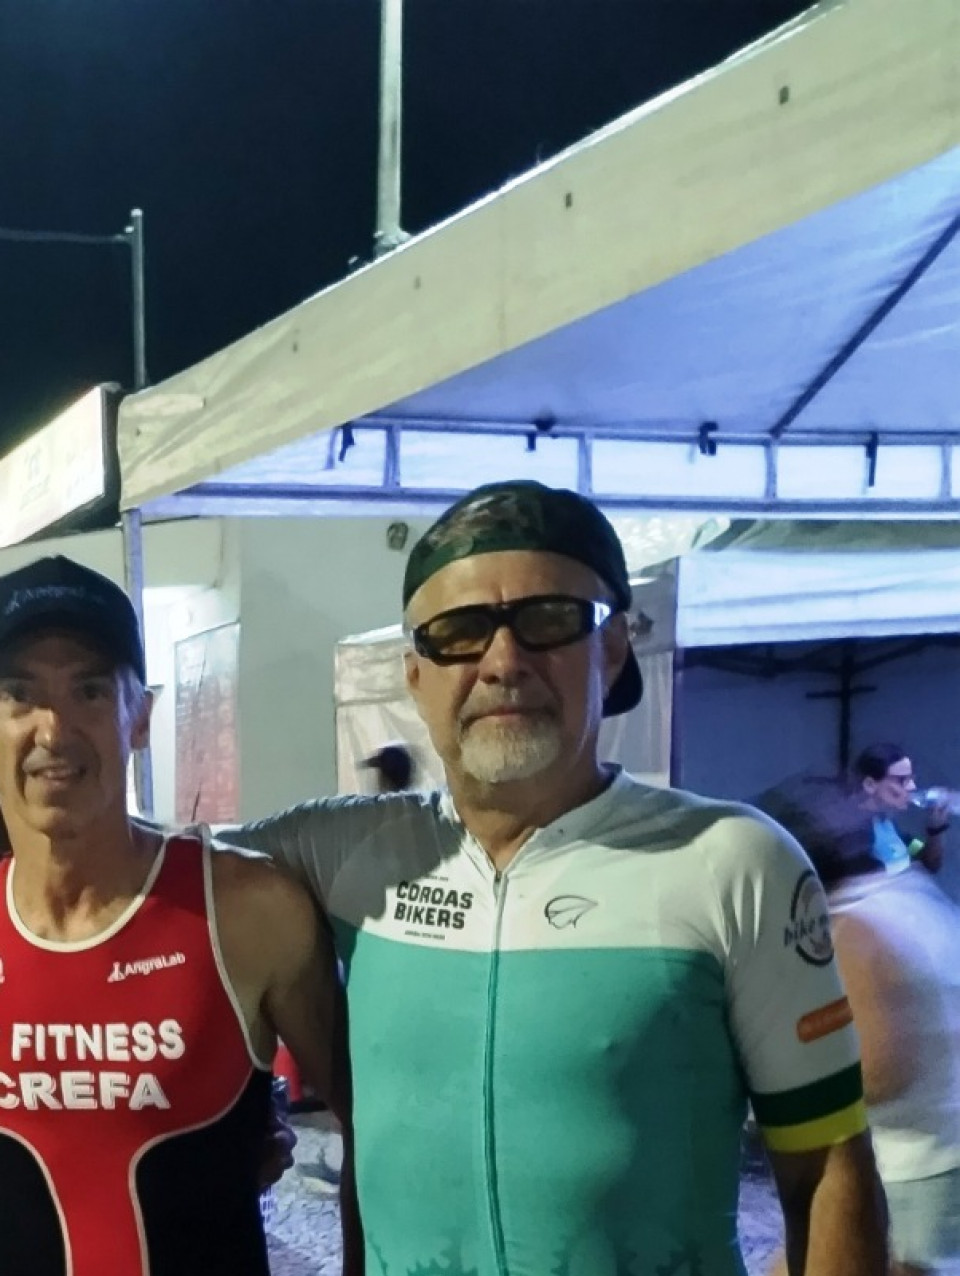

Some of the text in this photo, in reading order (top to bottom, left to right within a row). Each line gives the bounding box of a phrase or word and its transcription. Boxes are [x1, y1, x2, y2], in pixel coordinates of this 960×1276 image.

[397, 881, 473, 909] COROAS
[394, 902, 465, 930] BIKERS
[11, 1018, 186, 1062] FITNESS
